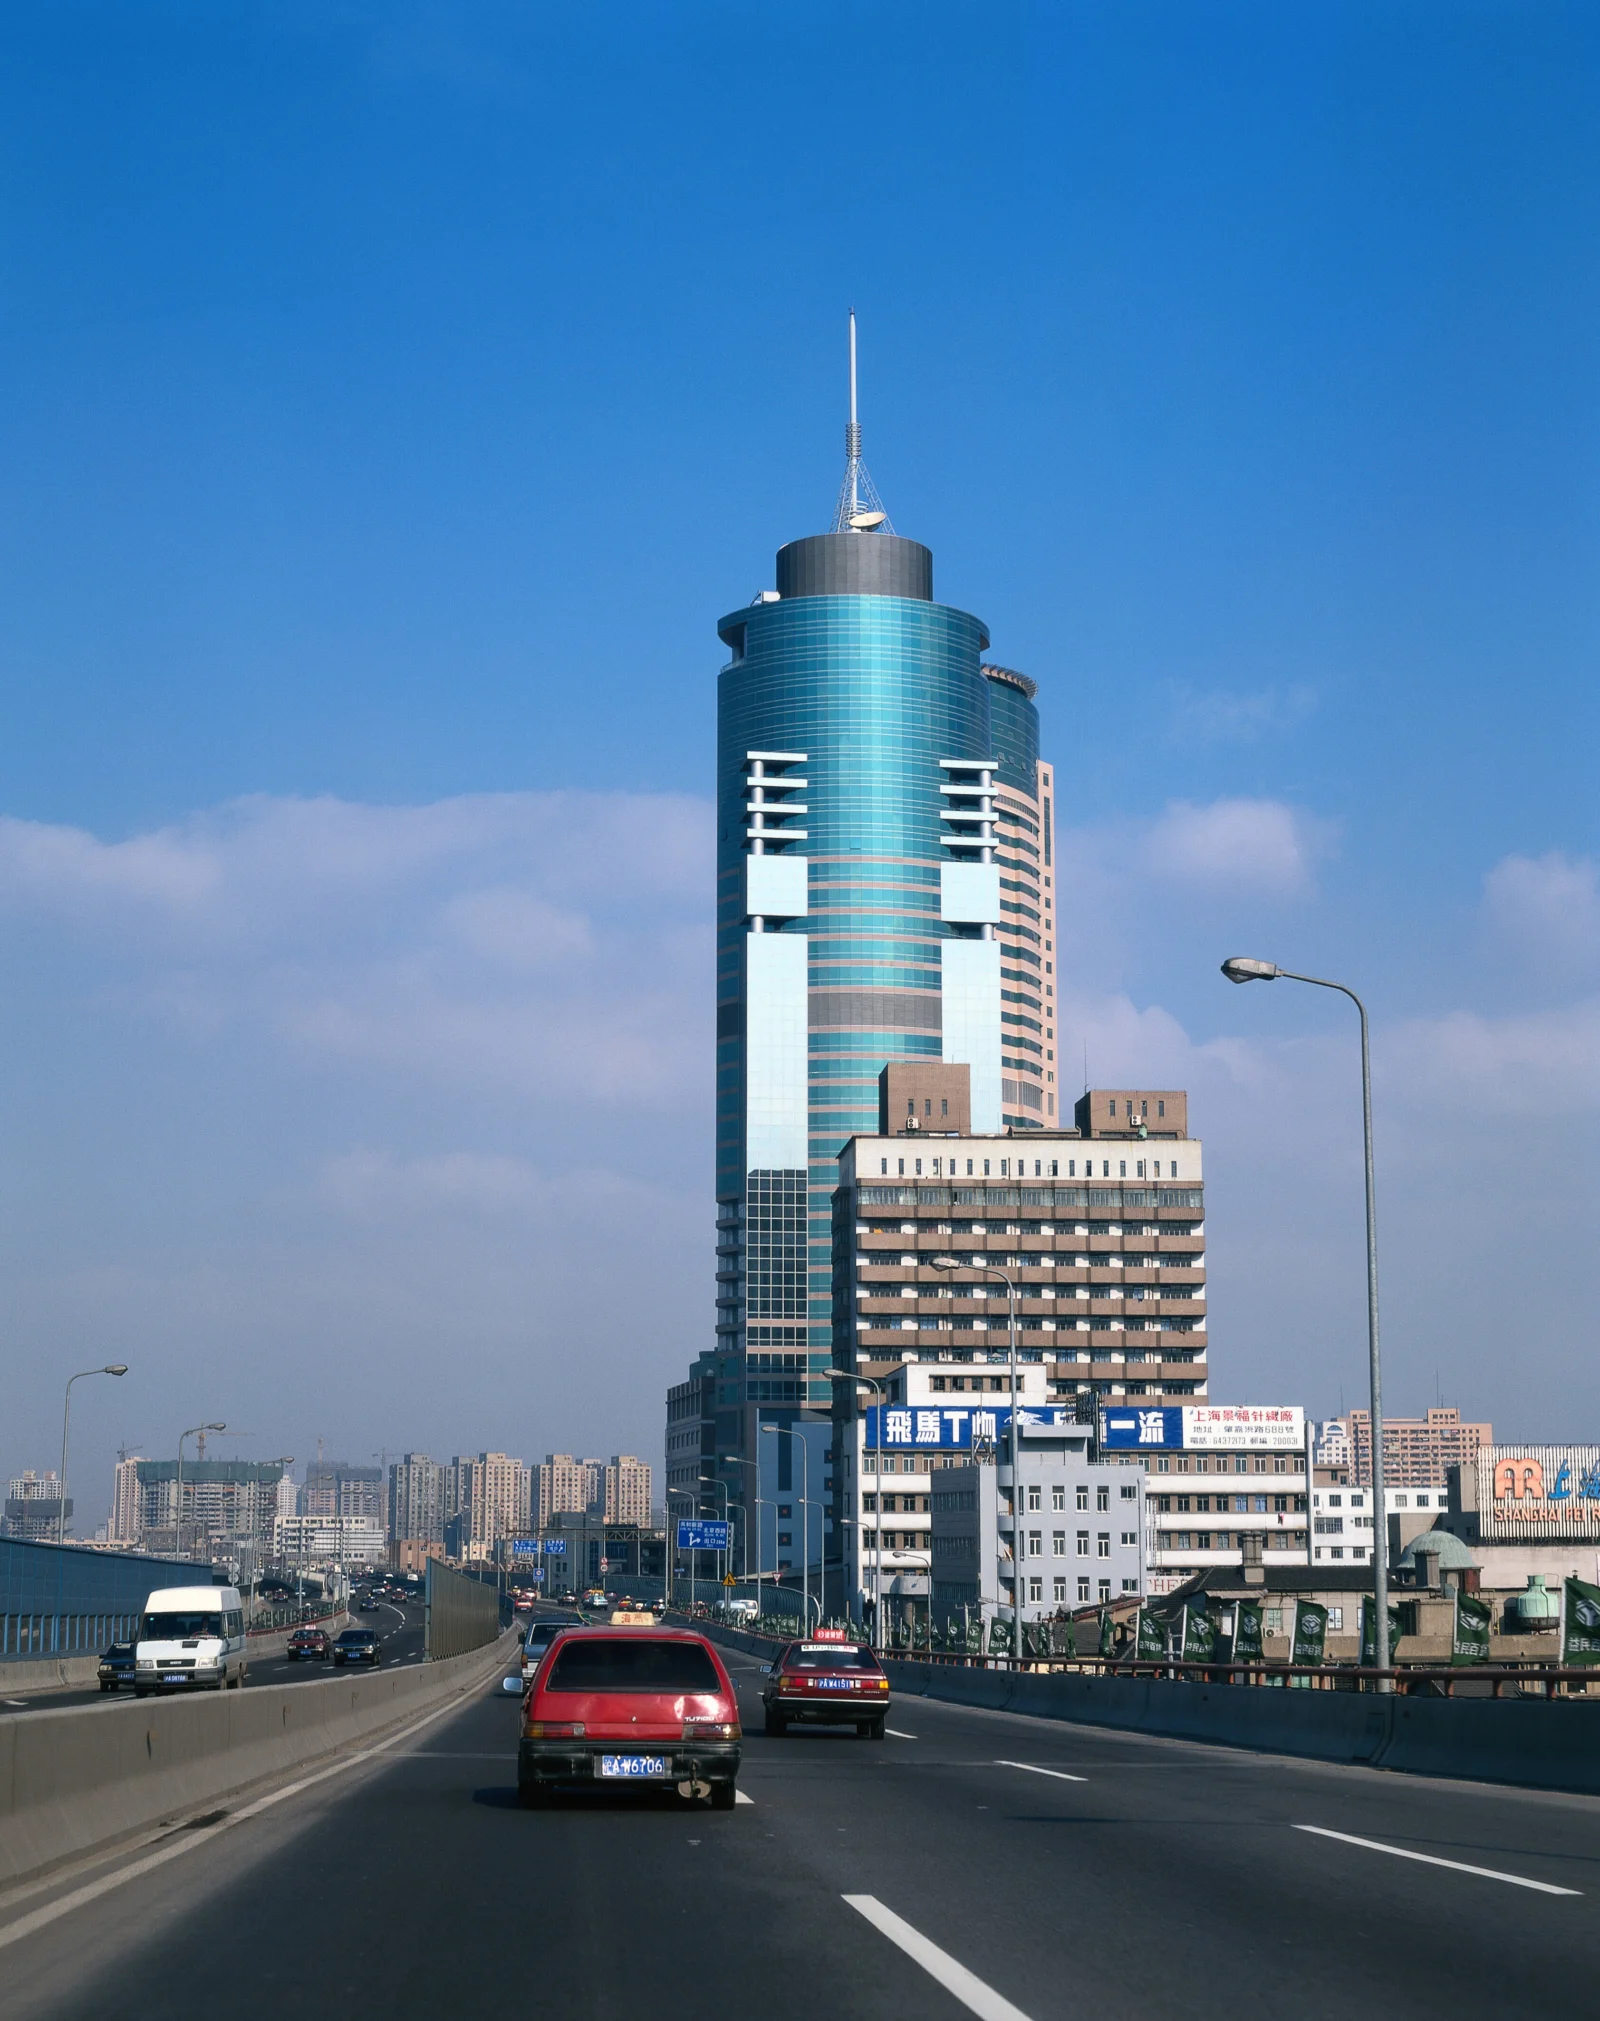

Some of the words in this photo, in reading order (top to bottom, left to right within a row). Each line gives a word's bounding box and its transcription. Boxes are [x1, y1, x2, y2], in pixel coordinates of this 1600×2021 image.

[886, 1410, 996, 1443] 飛馬T恤
[1494, 1508, 1561, 1522] SHANGHAI
